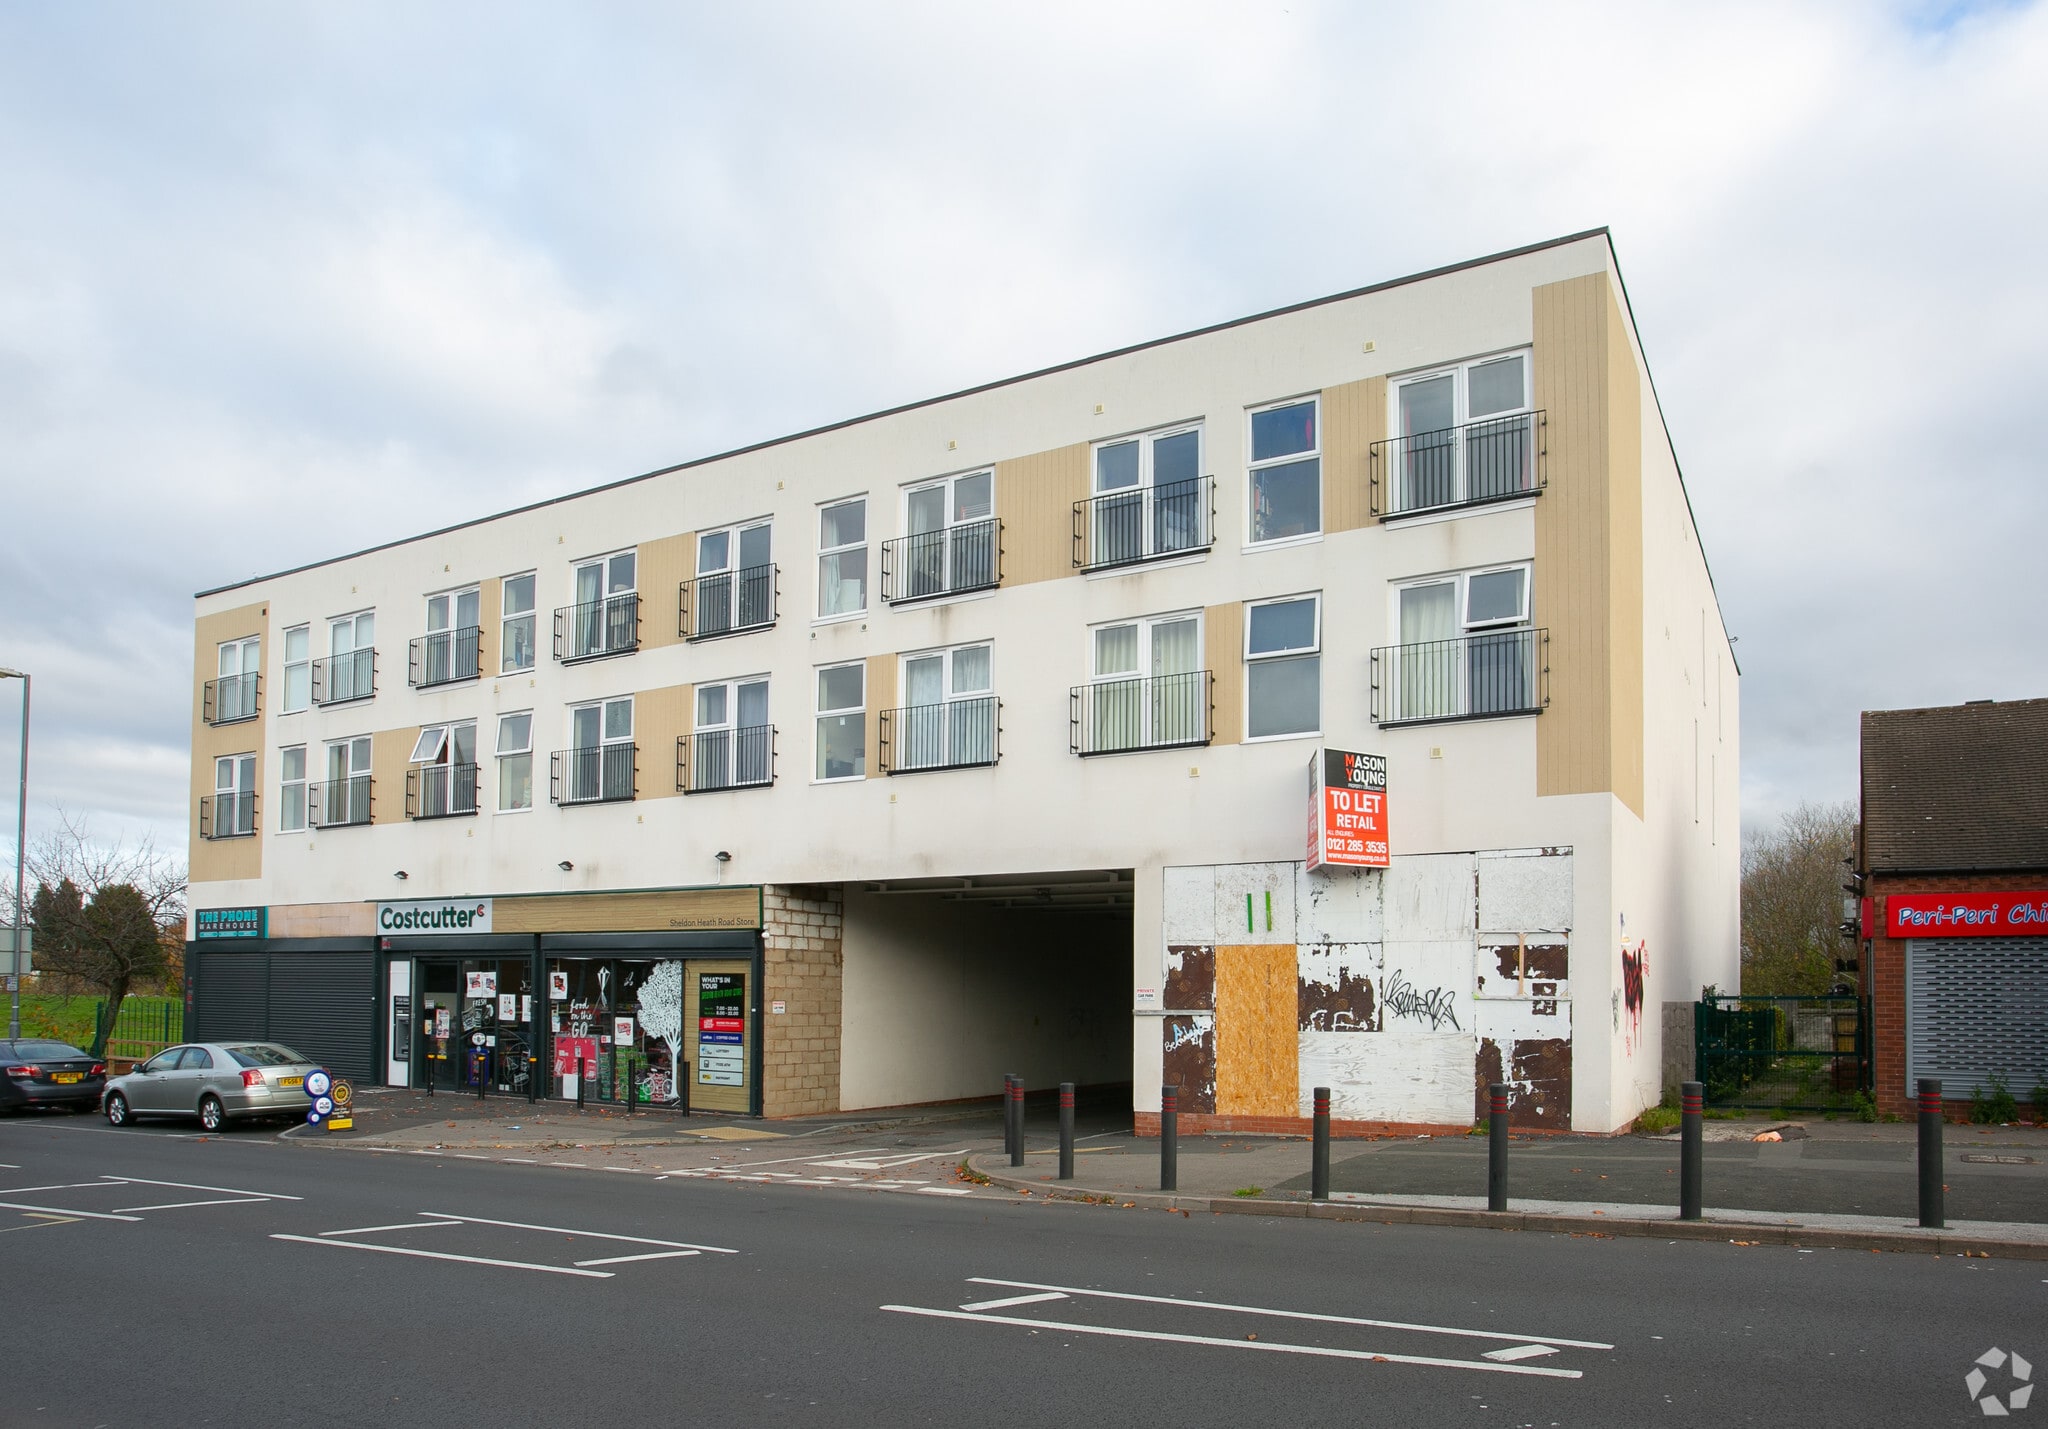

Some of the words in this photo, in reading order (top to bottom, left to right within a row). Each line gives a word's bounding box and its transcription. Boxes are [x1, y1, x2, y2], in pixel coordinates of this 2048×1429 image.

[1344, 753, 1385, 772] MASON
[1345, 767, 1385, 787] YOUNG
[1330, 790, 1350, 811] TO
[1354, 792, 1381, 813] LET
[1336, 813, 1377, 830] RETAIL
[1327, 838, 1345, 851] 0121
[1347, 839, 1364, 852] 285
[1365, 841, 1387, 854] 3535
[1327, 853, 1387, 863] www.masonyoung.co.uk
[199, 911, 219, 923] THE
[221, 909, 258, 922] PHONE
[380, 905, 476, 930] Costcutter
[669, 918, 696, 927] Sheldon
[697, 918, 717, 927] Heath
[718, 917, 735, 926] Road
[736, 917, 755, 926] Store
[1898, 903, 1999, 926] Peri-Peri
[2008, 902, 2048, 923] Chi
[199, 922, 258, 930] WAREHOUSE
[701, 976, 724, 984] WHAT'S
[569, 998, 590, 1014] food
[580, 1011, 593, 1020] the
[571, 1021, 588, 1038] GO
